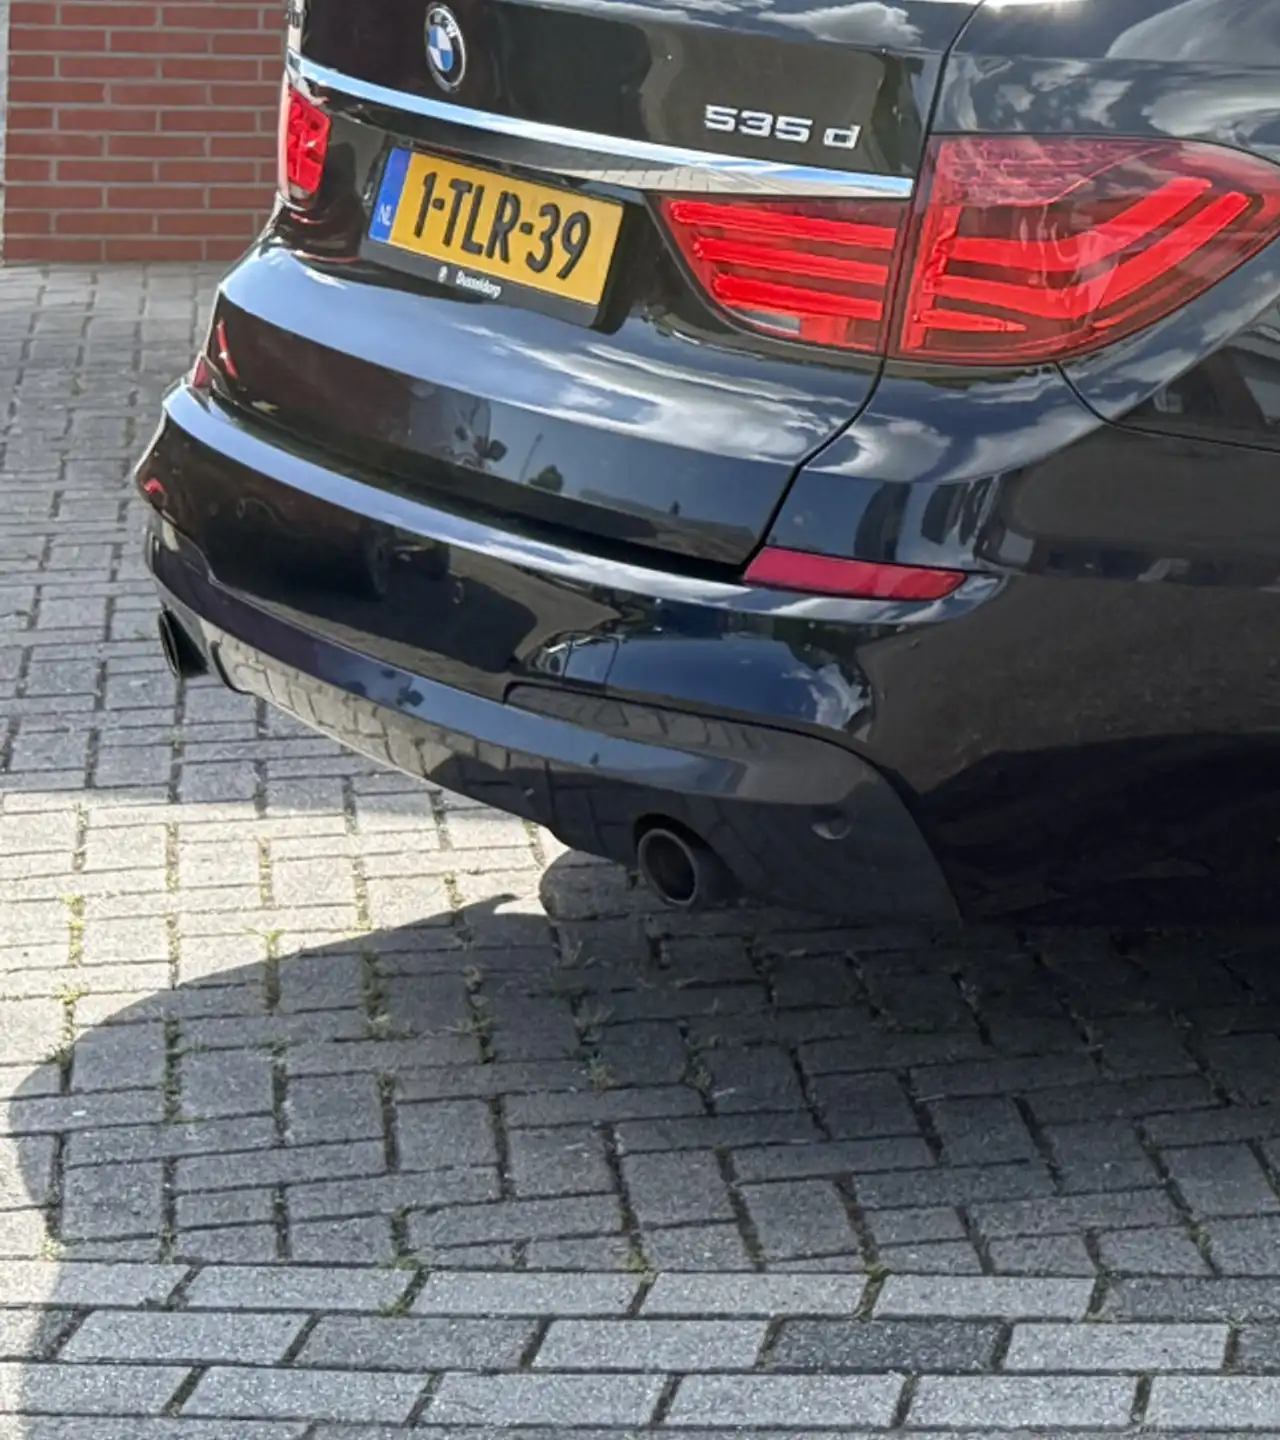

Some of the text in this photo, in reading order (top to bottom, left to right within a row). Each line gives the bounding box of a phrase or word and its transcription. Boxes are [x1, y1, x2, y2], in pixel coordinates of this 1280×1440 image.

[703, 103, 862, 150] 535 d
[413, 171, 591, 281] 1-TLR-39
